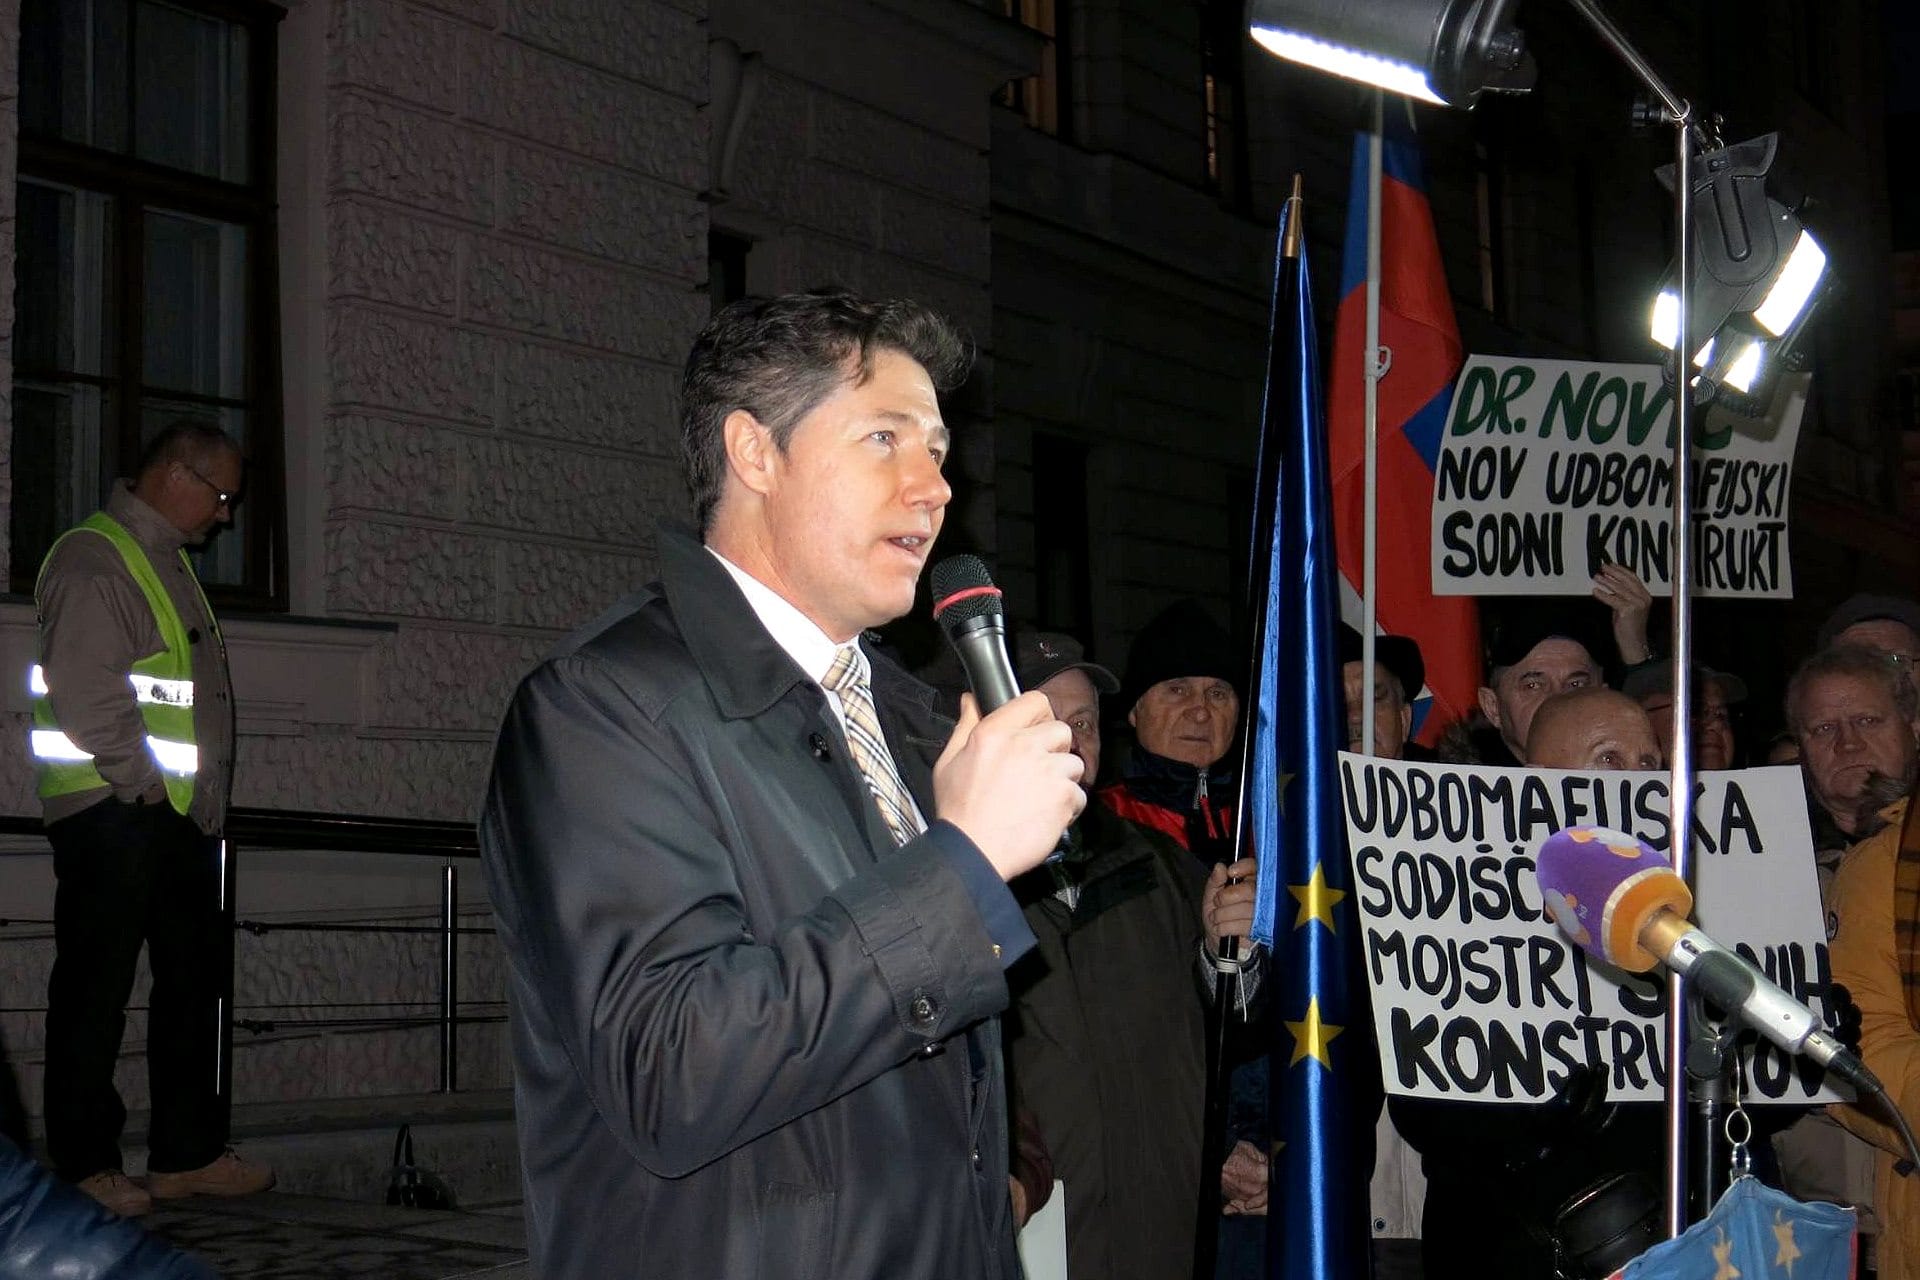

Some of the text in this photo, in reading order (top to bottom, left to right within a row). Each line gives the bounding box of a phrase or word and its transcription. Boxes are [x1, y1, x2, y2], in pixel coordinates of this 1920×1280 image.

[1451, 365, 1536, 436] DR.
[1438, 445, 1528, 501] NOV
[1442, 509, 1564, 578] SODNI
[1355, 844, 1554, 924] SODIŠČ
[1367, 927, 1593, 1015] MOJSTRI
